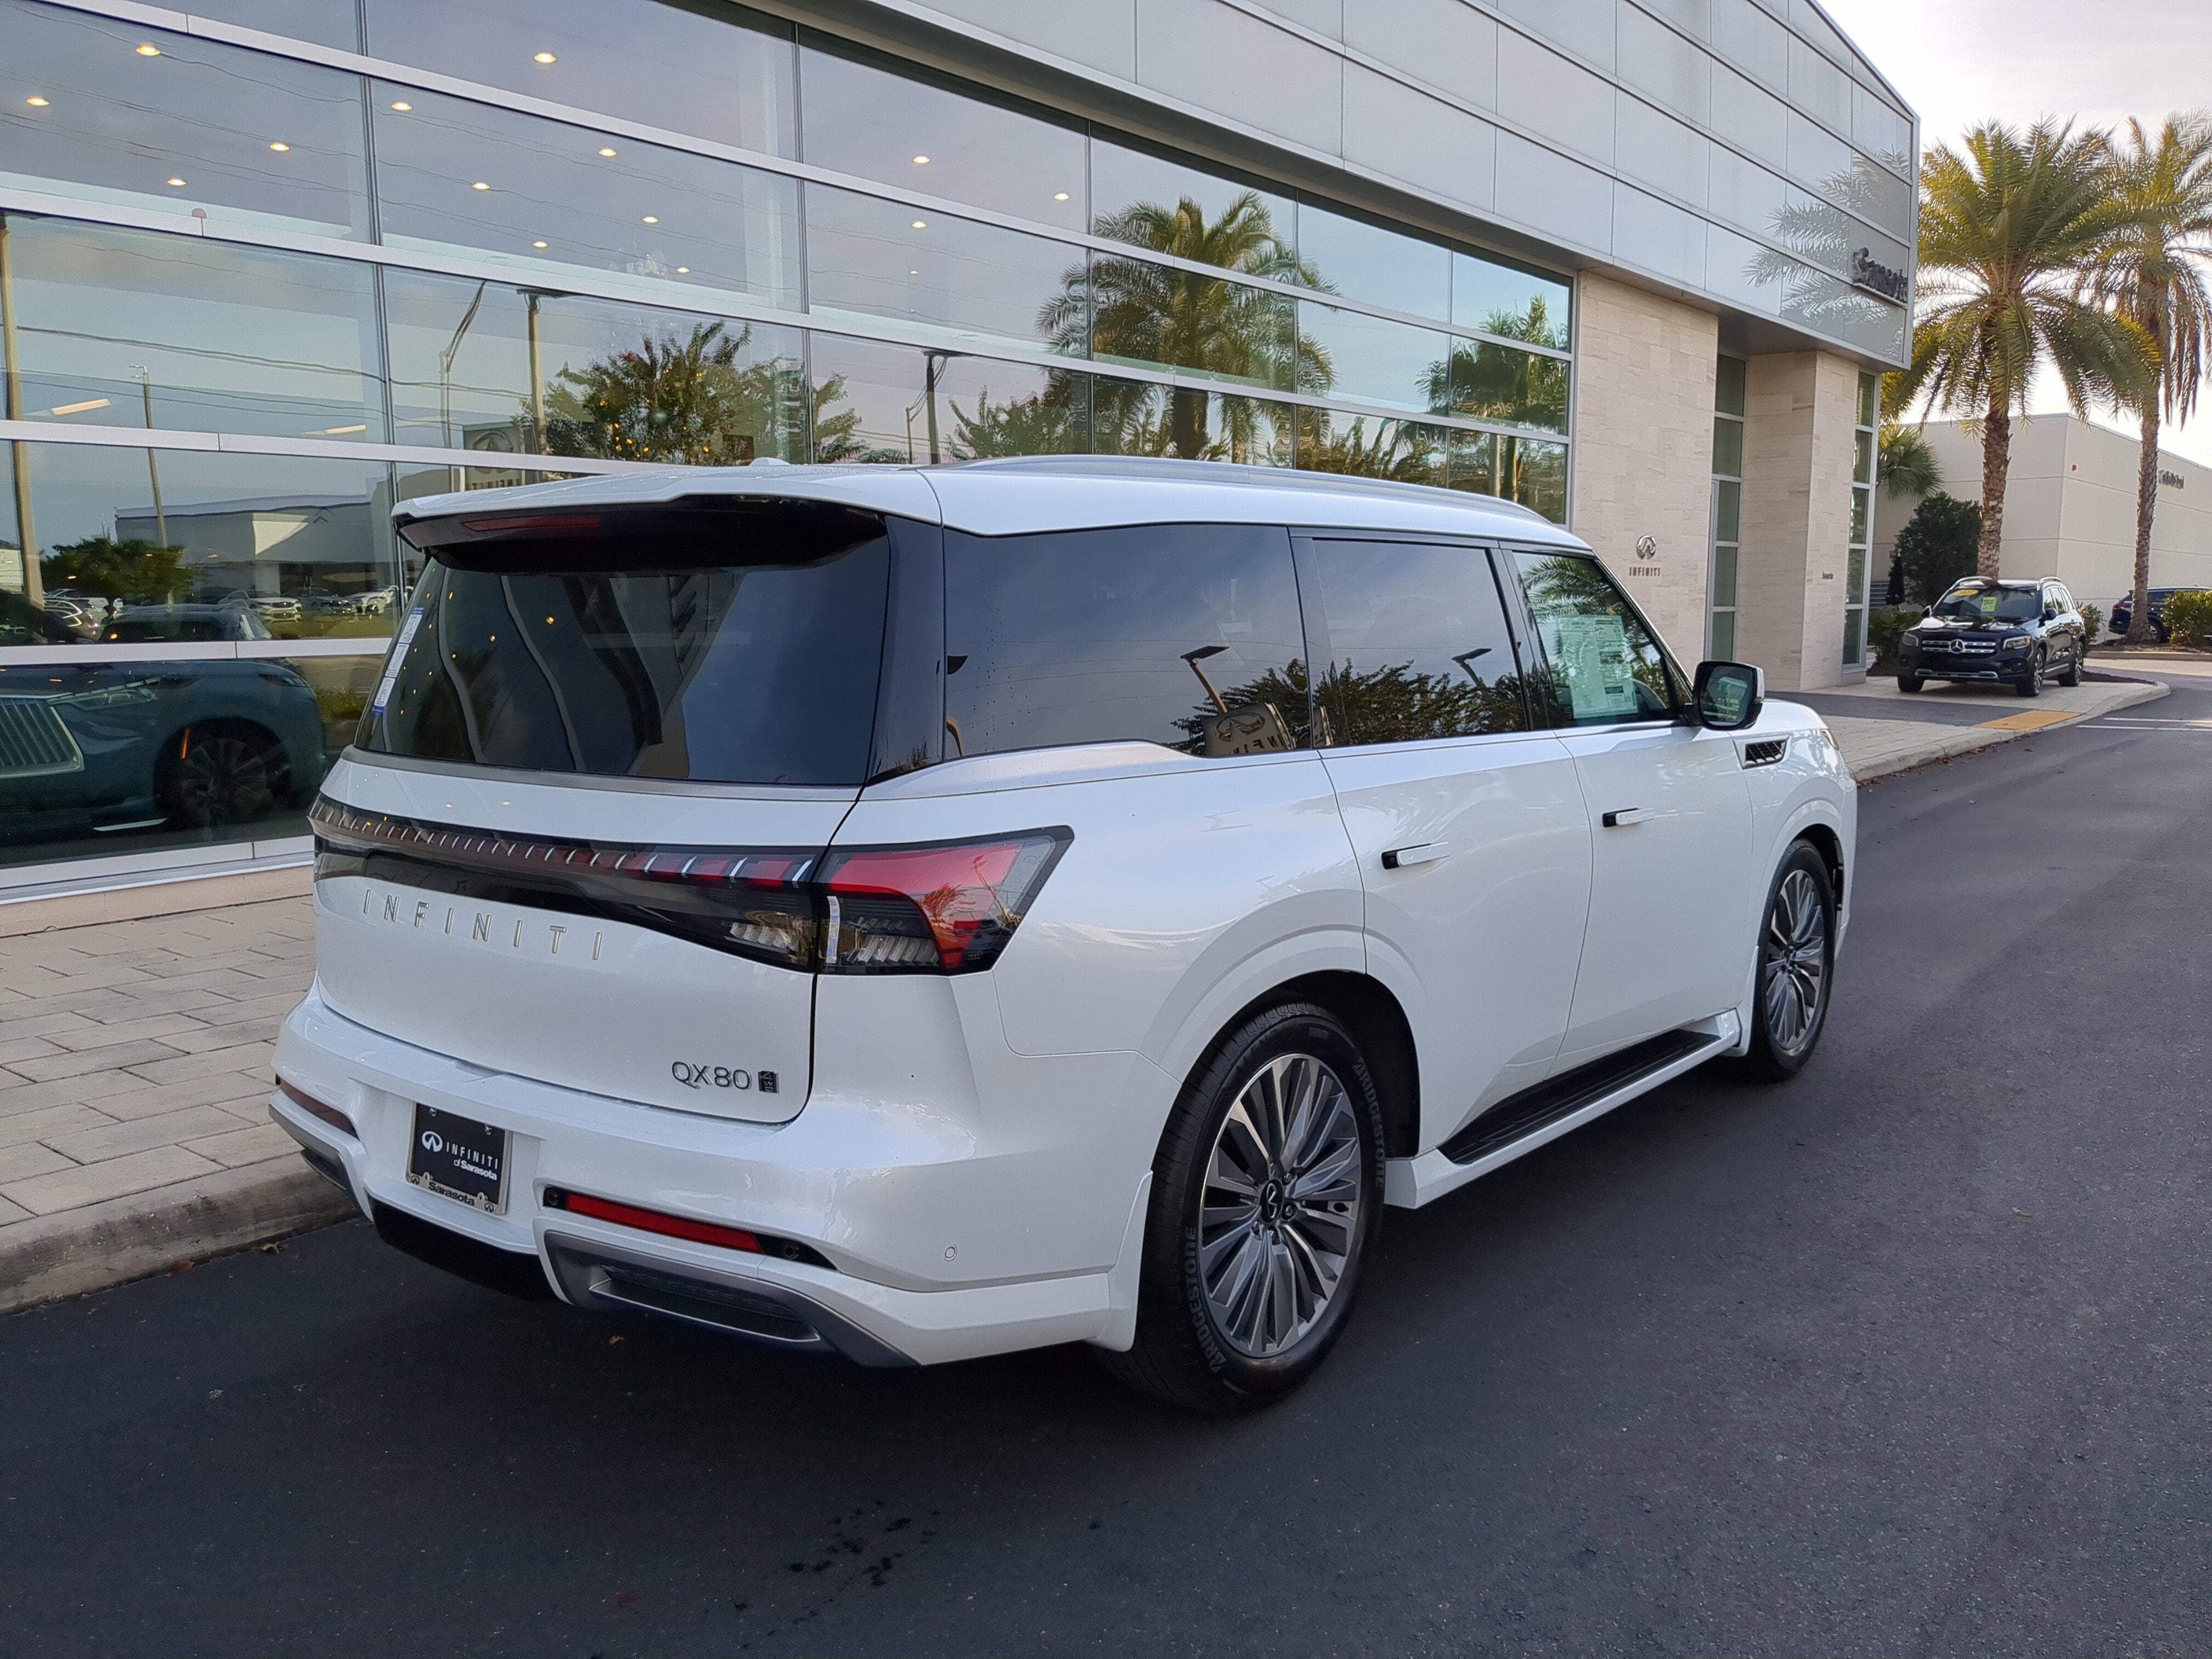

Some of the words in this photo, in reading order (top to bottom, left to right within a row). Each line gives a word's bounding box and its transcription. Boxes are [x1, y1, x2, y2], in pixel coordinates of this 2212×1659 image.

[1629, 567, 1660, 577] INFINITI
[363, 889, 602, 960] INFINITI
[672, 1061, 752, 1090] QX80
[446, 1142, 498, 1169] INFINITI
[454, 1159, 460, 1167] of
[461, 1160, 498, 1181] Sarasota
[428, 1181, 475, 1206] Sarasota
[1184, 1227, 1227, 1373] BRIDGESTONE
